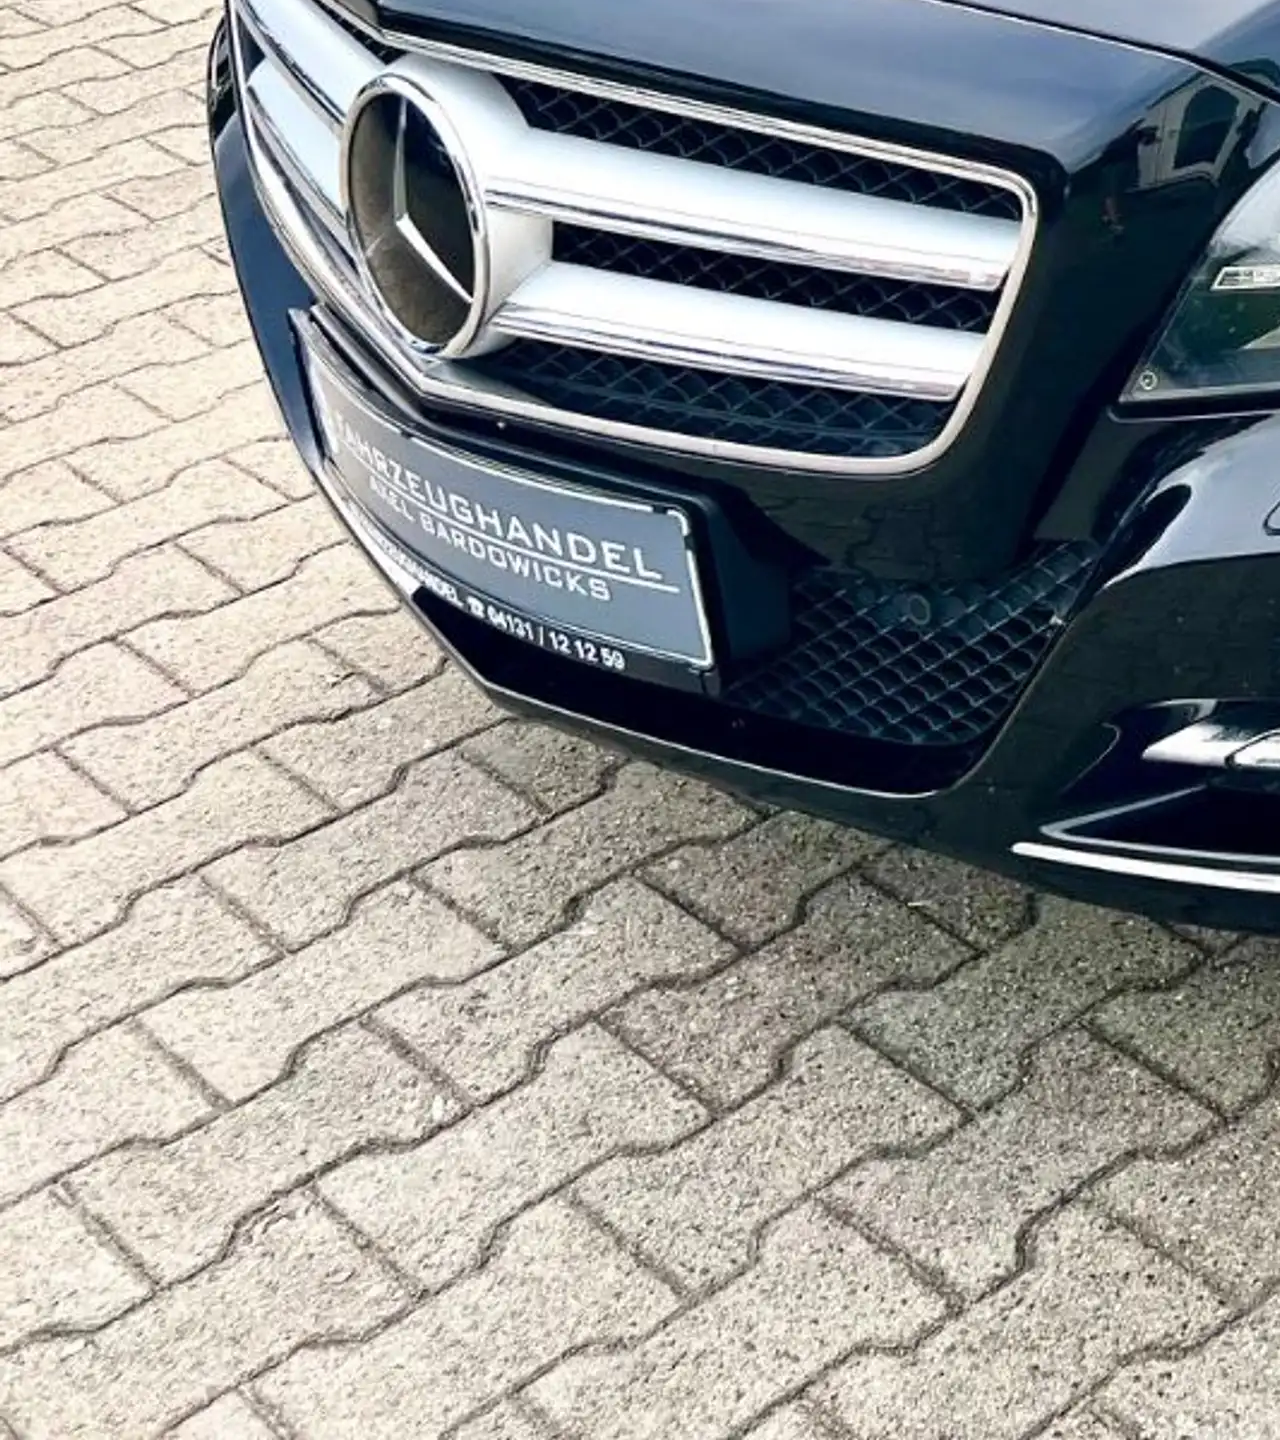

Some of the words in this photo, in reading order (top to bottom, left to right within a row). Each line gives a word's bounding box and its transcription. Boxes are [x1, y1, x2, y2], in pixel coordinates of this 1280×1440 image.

[420, 510, 611, 602] BARDOWICKS
[550, 631, 573, 655] 12
[574, 639, 599, 663] 12
